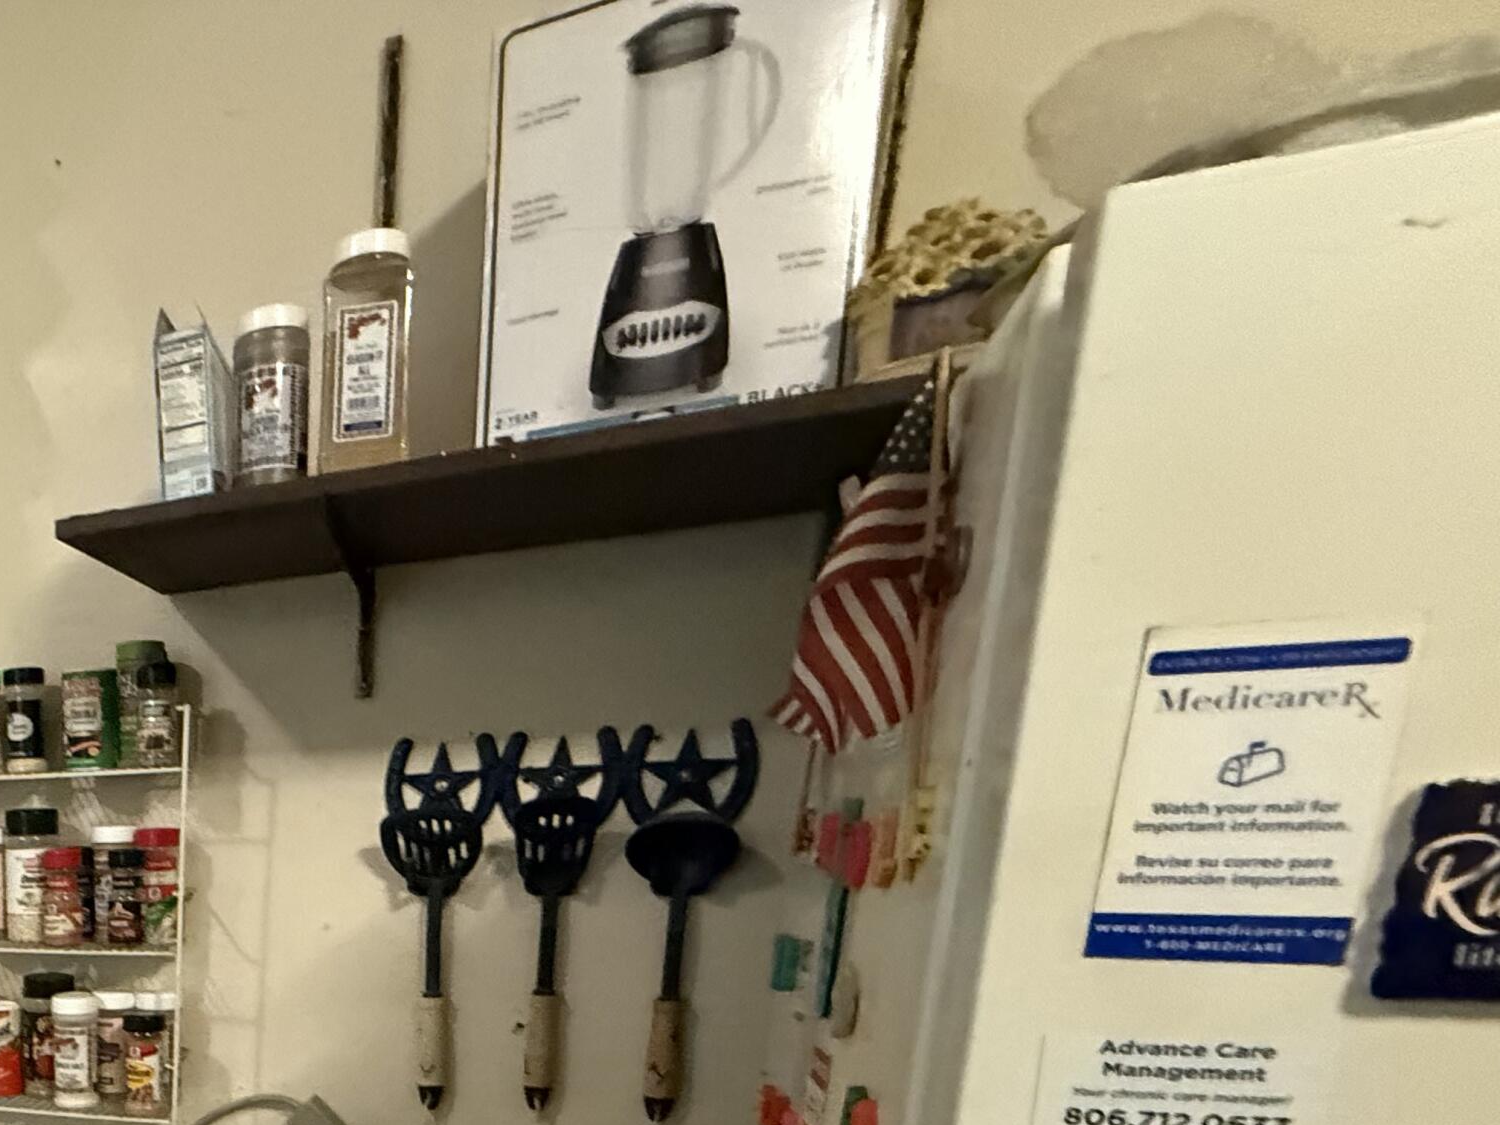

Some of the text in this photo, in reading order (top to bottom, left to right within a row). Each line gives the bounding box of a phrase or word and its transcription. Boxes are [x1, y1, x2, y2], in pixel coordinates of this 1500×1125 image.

[1150, 800, 1341, 819] Watch your mail for
[1133, 818, 1352, 836] important information.
[1135, 854, 1334, 872] Revise su correo para
[1099, 1039, 1277, 1060] Advance Care
[1101, 1061, 1268, 1083] Management
